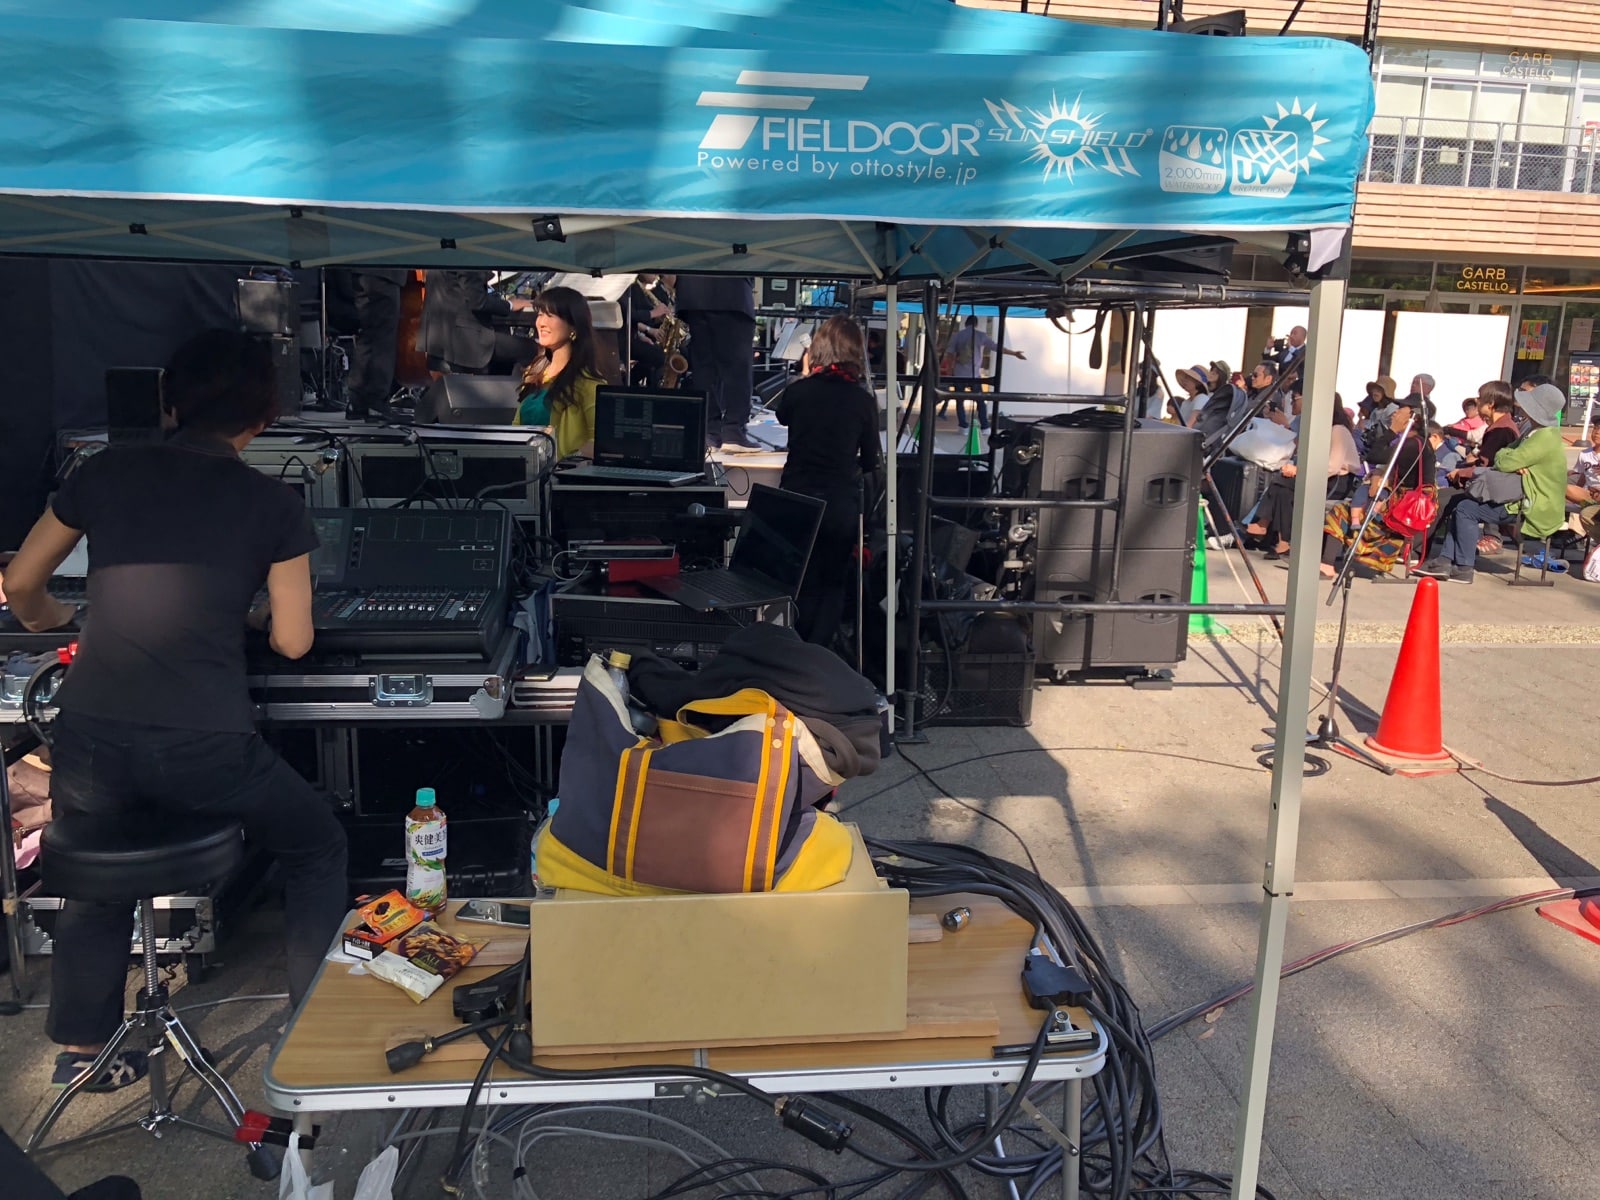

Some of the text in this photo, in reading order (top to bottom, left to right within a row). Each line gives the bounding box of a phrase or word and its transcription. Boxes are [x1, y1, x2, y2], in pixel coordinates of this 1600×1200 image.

[1509, 51, 1552, 66] GARB
[1502, 65, 1555, 78] CASTELLO
[763, 117, 980, 156] FIELDOOR
[697, 151, 977, 186] Powered by ottostyle.jp
[1164, 167, 1222, 181] 2,000mm
[1237, 160, 1280, 185] UV
[1462, 266, 1506, 280] GARB
[1456, 280, 1509, 291] CASTELLO
